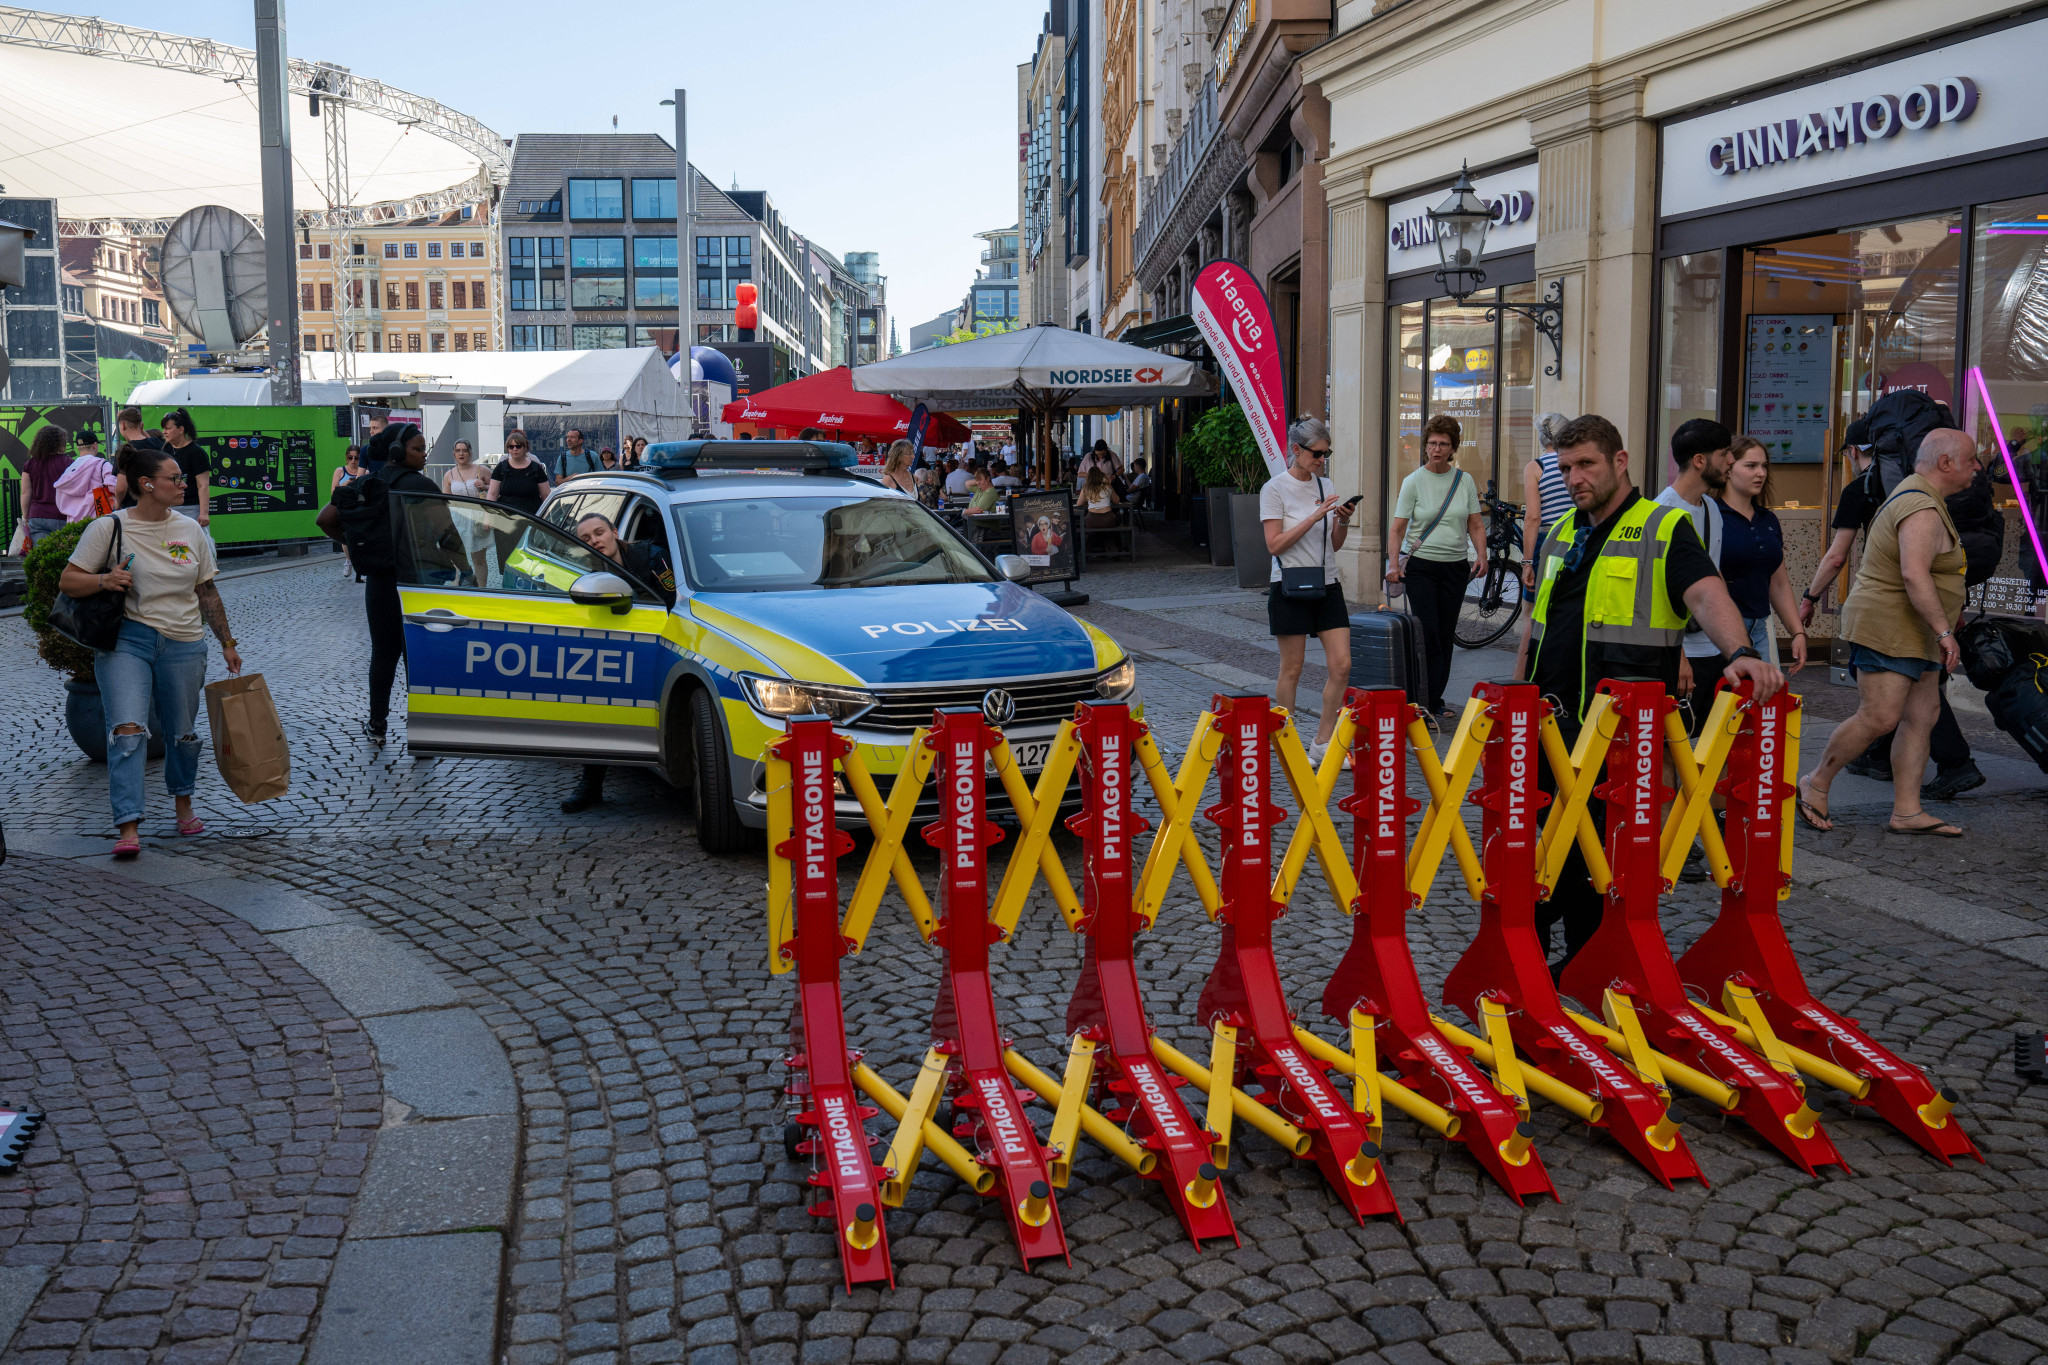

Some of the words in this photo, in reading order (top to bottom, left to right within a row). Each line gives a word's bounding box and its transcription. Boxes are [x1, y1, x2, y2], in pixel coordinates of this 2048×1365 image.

[1706, 76, 1971, 176] CINNAMOOD
[527, 314, 625, 322] MESSEHAUS
[645, 314, 664, 322] AM
[693, 314, 735, 322] ARKT
[1050, 368, 1133, 385] NORDSEE
[1197, 310, 1219, 343] Spende
[1216, 341, 1231, 362] Blut
[1227, 361, 1241, 379] und
[1236, 377, 1254, 411] Plasma
[1250, 411, 1267, 439] gleich
[1263, 438, 1278, 462] hier!
[1465, 409, 1480, 417] ROLLS
[1987, 592, 2006, 601] 09.30
[1989, 584, 2007, 593] 09.30
[2005, 602, 2022, 611] 19.30
[2024, 605, 2038, 613] UHR
[465, 640, 635, 684] POLIZEI
[860, 618, 1029, 639] POLIZEI
[1102, 735, 1120, 860] PITAGONE
[1241, 723, 1260, 846] PITAGONE
[1378, 717, 1395, 838] PITAGONE
[1508, 711, 1528, 830] PITAGONE
[1635, 708, 1654, 825] PITAGONE
[1757, 706, 1777, 820] PITAGONE
[803, 750, 825, 879] PITAGONE
[955, 741, 975, 868] PITAGONE
[1418, 1037, 1493, 1105] PITAGONE
[1549, 1025, 1632, 1090] PITAGONE
[1676, 1014, 1766, 1078] PITAGONE
[1802, 1009, 1898, 1071] PITAGONE
[978, 1077, 1026, 1154] PITAGONE
[1129, 1063, 1186, 1138] PITAGONE
[1274, 1048, 1341, 1118] PITAGONE
[824, 1096, 861, 1177] PITAGONE
